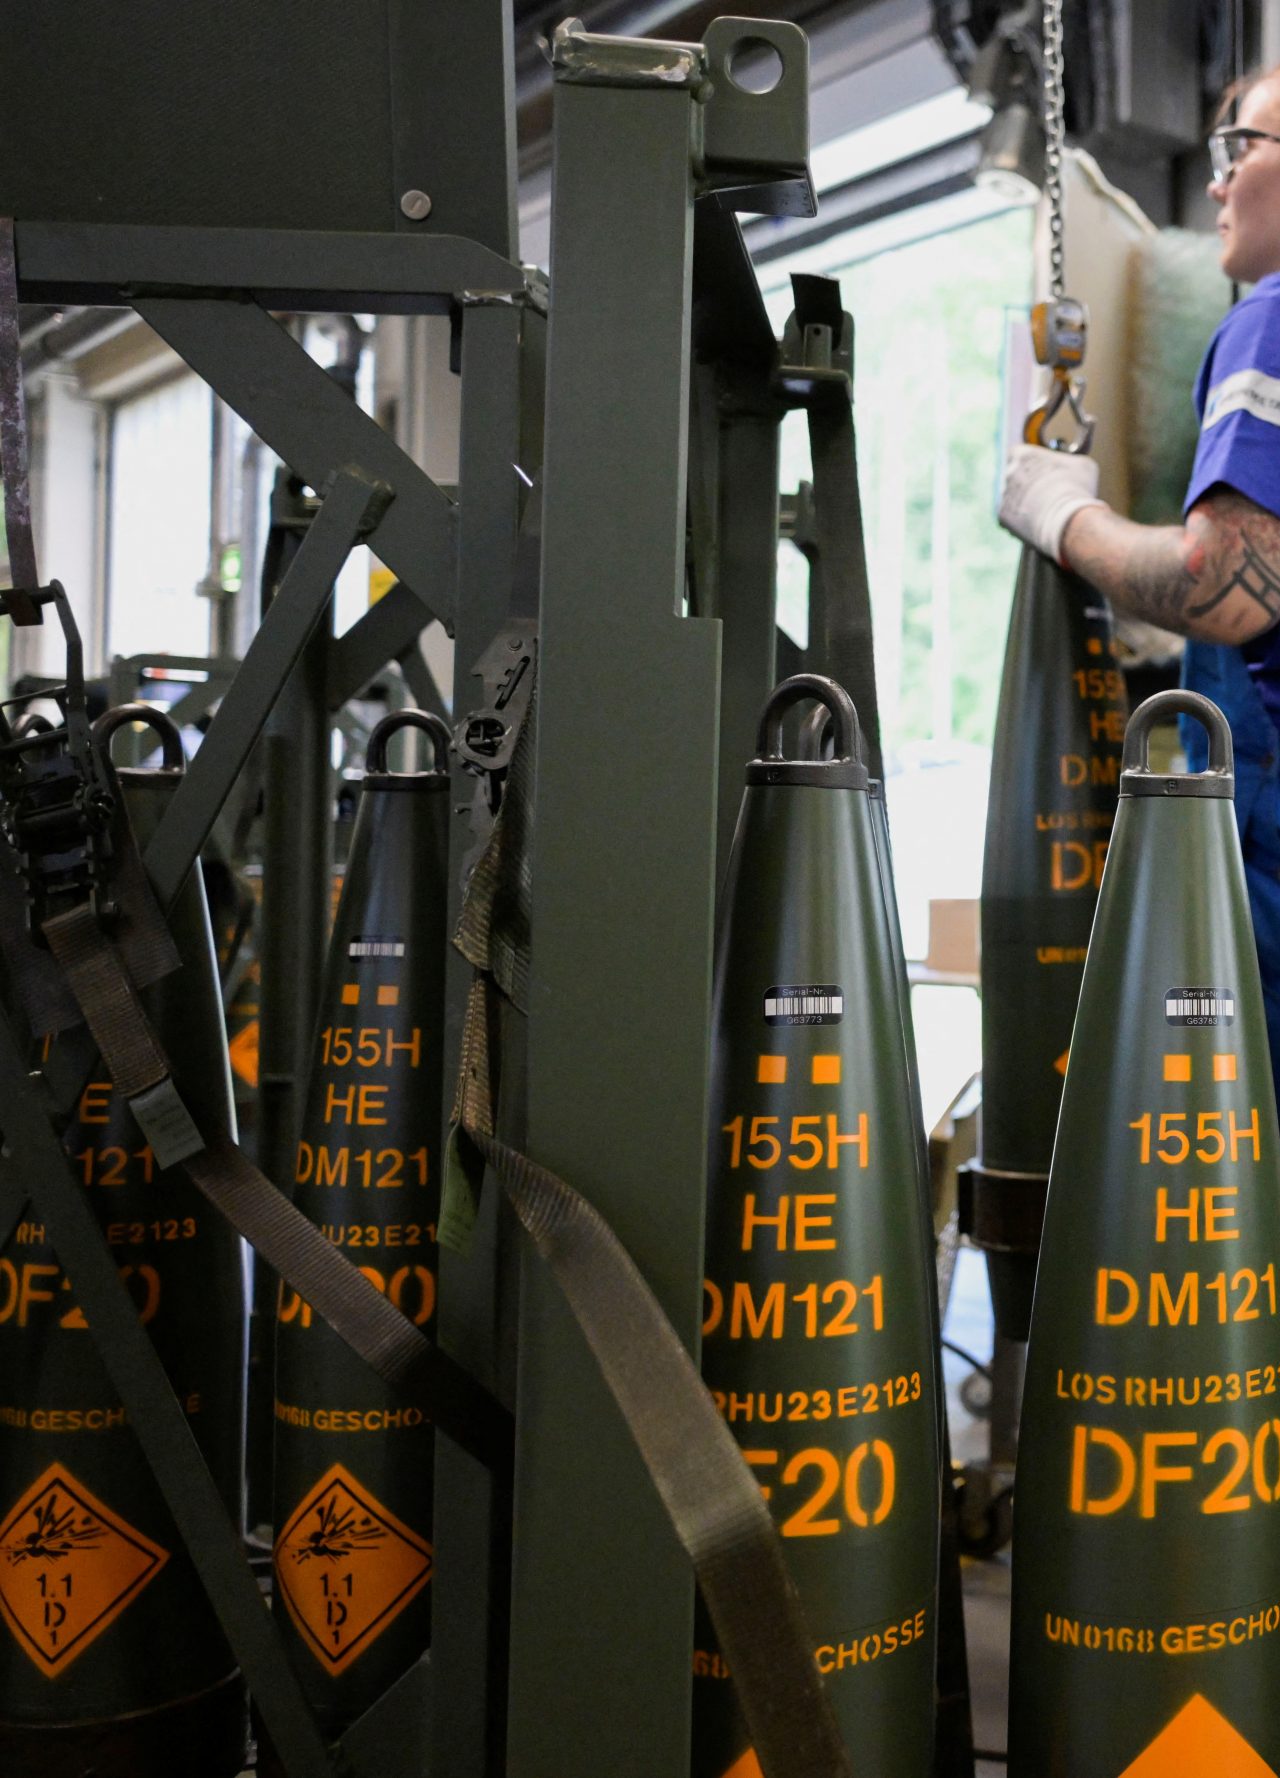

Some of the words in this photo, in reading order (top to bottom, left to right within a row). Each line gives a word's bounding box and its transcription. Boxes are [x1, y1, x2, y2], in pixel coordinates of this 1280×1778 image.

[782, 988, 826, 997] Serial-Nr.
[1182, 990, 1219, 998] Serial-N
[323, 1027, 420, 1067] 155H
[325, 1085, 386, 1125] HE
[727, 1113, 868, 1169] 155H
[1131, 1108, 1260, 1164] 155H
[80, 1146, 153, 1185] 121
[296, 1142, 426, 1188] DM121
[743, 1194, 836, 1251] HE
[1156, 1188, 1239, 1242] HE
[323, 1225, 434, 1247] U23E21
[1096, 1264, 1276, 1326] DM121
[1057, 1370, 1116, 1404] LOS
[313, 1407, 423, 1432] GESCHO
[36, 1573, 72, 1598] 1.1
[320, 1573, 353, 1597] 1.1
[45, 1601, 66, 1627] D
[327, 1600, 347, 1626] D
[50, 1630, 57, 1646] 1
[332, 1630, 340, 1645] 1
[815, 1610, 925, 1674] CHOSSE
